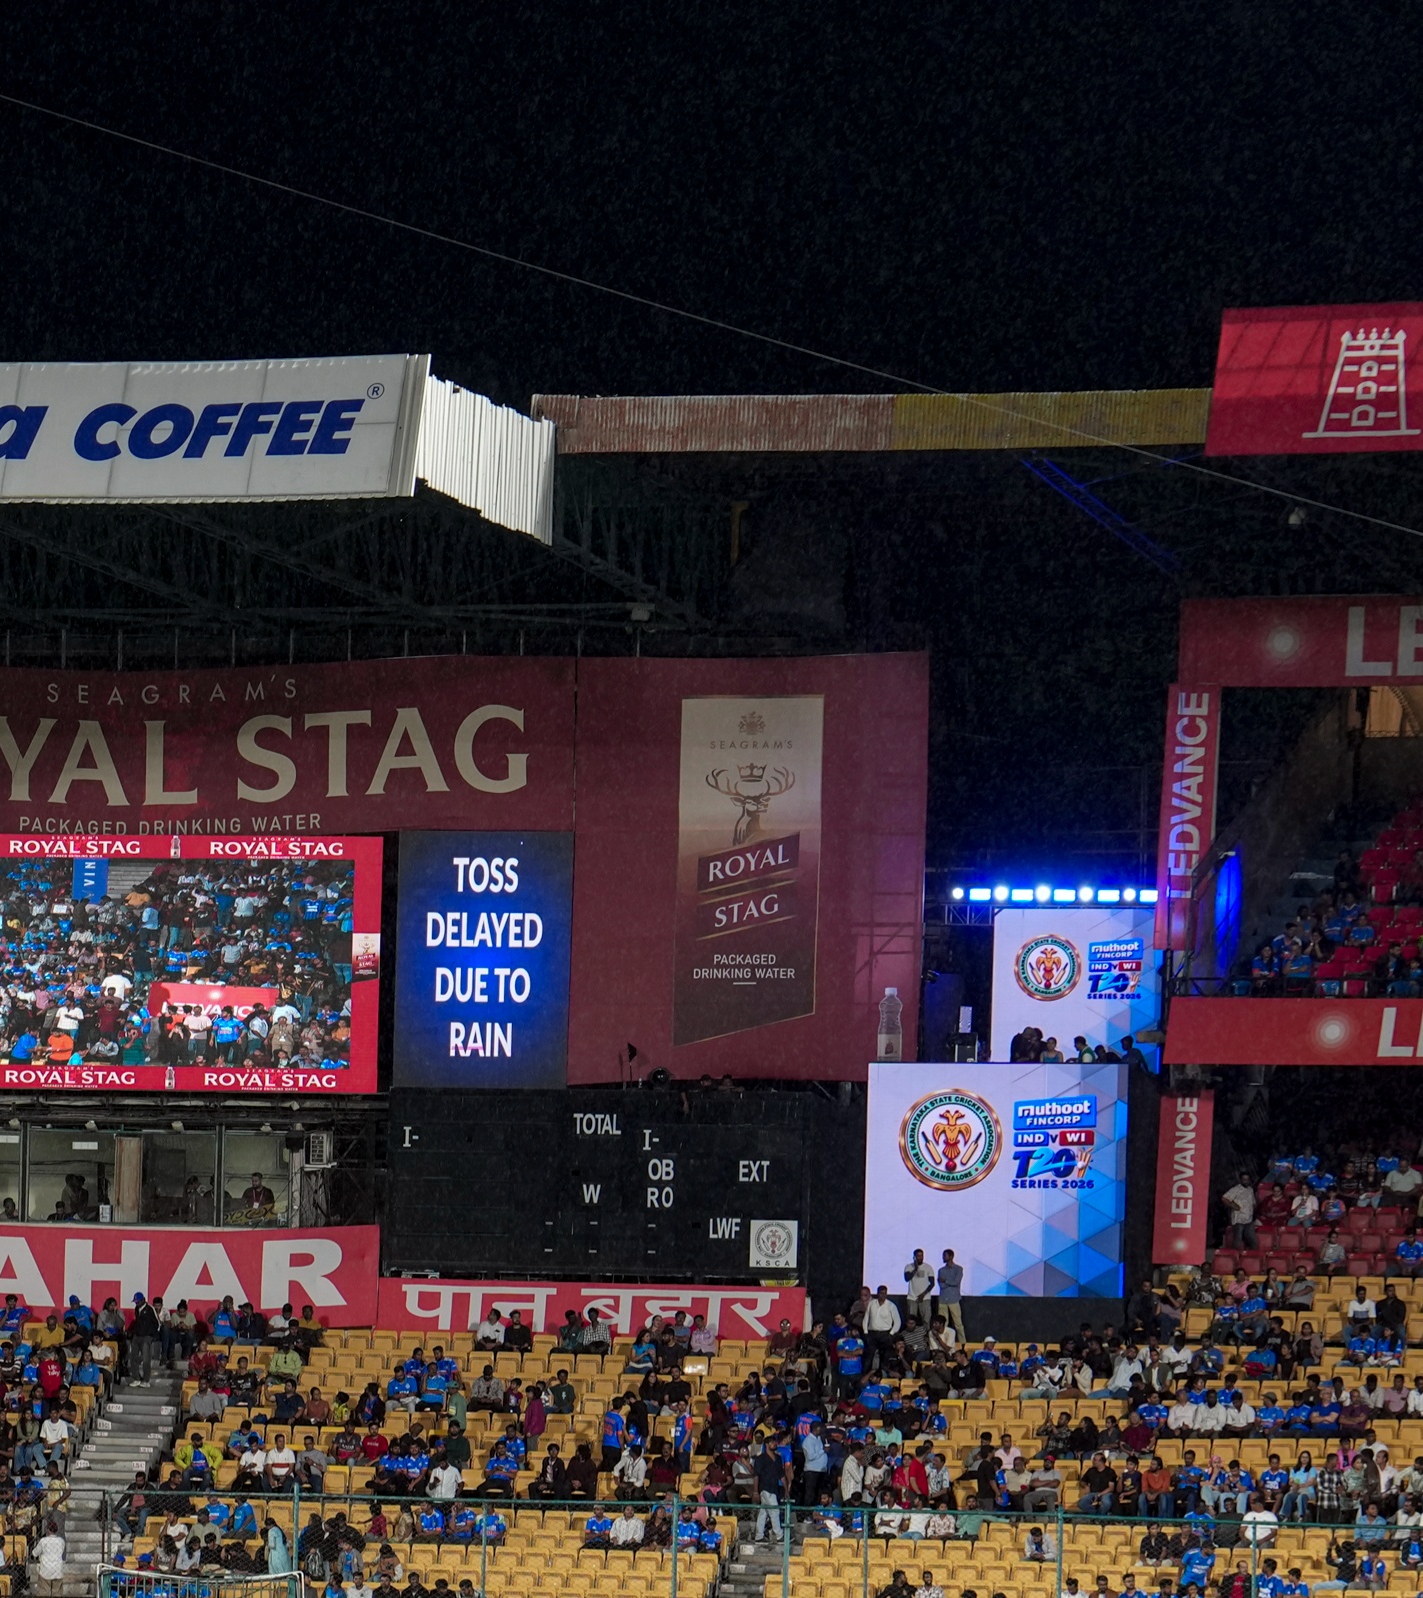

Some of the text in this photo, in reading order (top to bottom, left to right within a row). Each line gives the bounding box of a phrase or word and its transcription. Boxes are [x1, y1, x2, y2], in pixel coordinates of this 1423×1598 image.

[74, 398, 365, 461] COFFEE
[47, 676, 298, 706] SEAGRAM'S
[237, 704, 530, 802] STAG
[710, 740, 793, 749] SEAGRAM'S
[19, 814, 321, 836] PACKAGED DRINKING WATER
[210, 841, 343, 856] ROYAL STAG
[708, 844, 789, 882] ROYAL
[453, 857, 519, 892] TOSS
[714, 894, 779, 928] STAG
[426, 912, 543, 948] DELAYED
[1091, 941, 1139, 953] muthoot
[713, 954, 776, 965] PACKAGED
[693, 967, 795, 979] DRINKING WATER
[1088, 972, 1129, 993] T20
[435, 967, 531, 1003] DUE TO
[450, 1022, 512, 1057] RAIN
[204, 1073, 336, 1087] ROYAL STAG
[1018, 1100, 1090, 1117] muthoot
[573, 1113, 621, 1136] TOTAL
[908, 1096, 995, 1166] KARNATAKA STATE CRICKET ASSOCIATION
[1026, 1116, 1080, 1126] FINCORP
[1017, 1132, 1085, 1143] IND WI
[648, 1159, 674, 1181] OB
[739, 1161, 770, 1182] EXT
[1013, 1147, 1075, 1179] T20
[1171, 1097, 1198, 1229] LEDVANCE
[930, 1170, 973, 1182] BANGALORE
[1011, 1180, 1094, 1189] SERIES 2026
[583, 1184, 601, 1204] W
[709, 1218, 740, 1239] LWF
[402, 1284, 779, 1337] पान बहार
